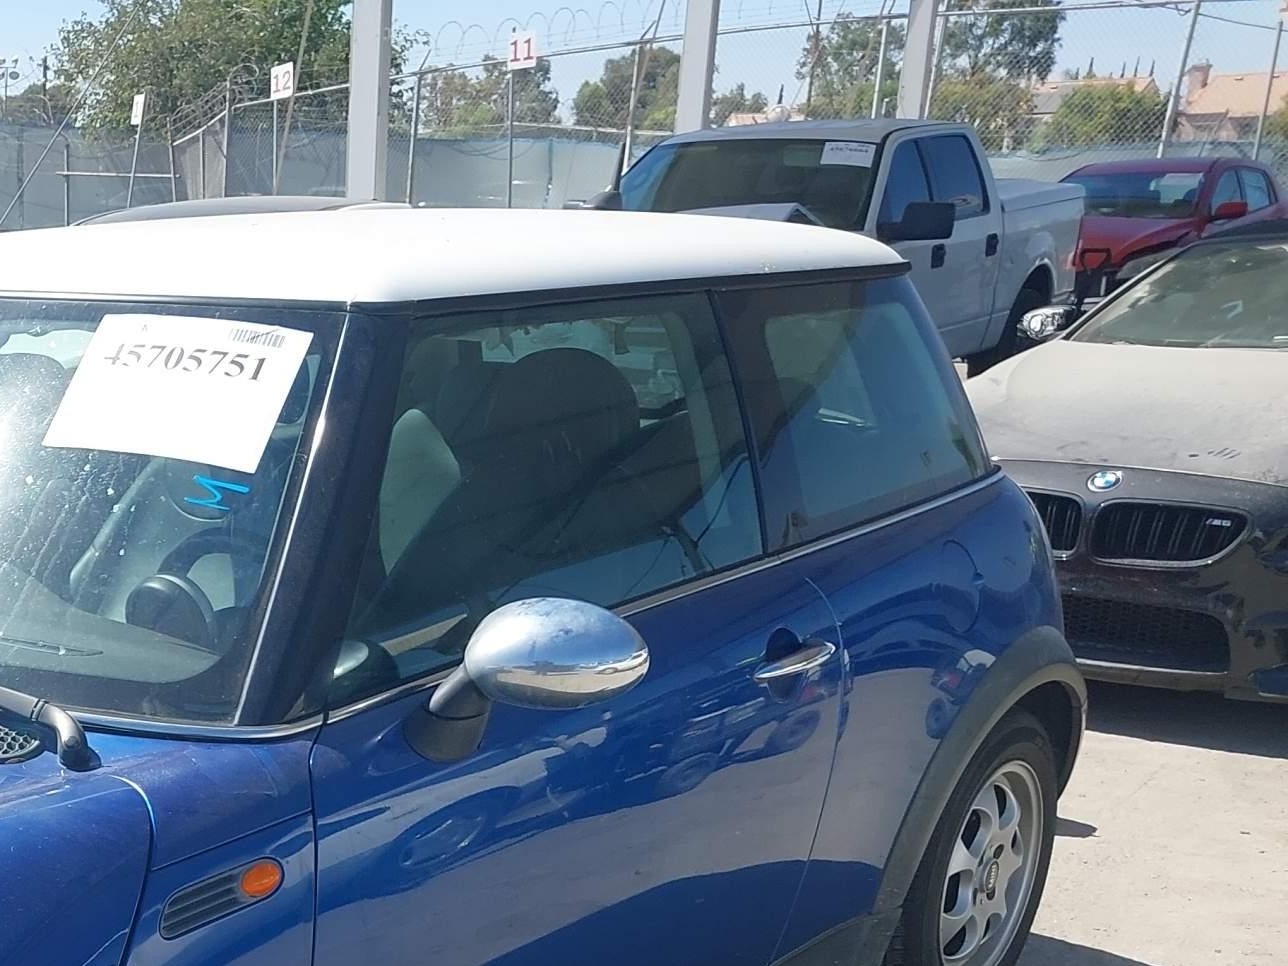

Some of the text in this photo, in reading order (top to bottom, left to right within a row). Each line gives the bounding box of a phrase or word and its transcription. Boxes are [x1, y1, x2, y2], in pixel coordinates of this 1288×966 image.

[510, 38, 535, 63] 11
[272, 70, 291, 94] 12
[104, 343, 268, 382] 45705751
